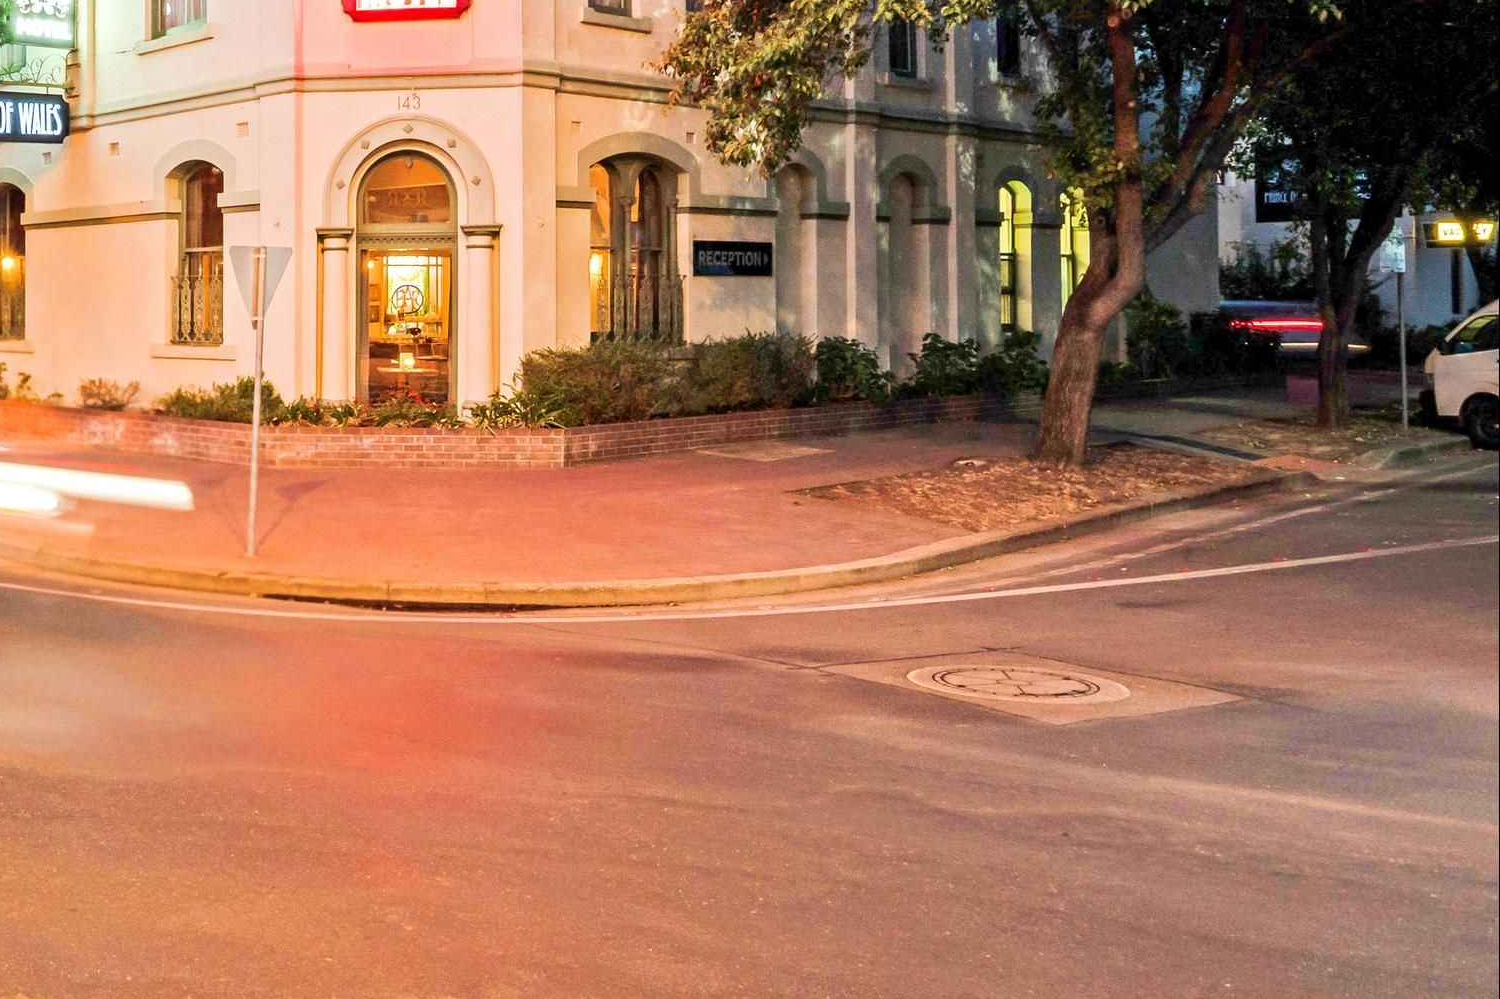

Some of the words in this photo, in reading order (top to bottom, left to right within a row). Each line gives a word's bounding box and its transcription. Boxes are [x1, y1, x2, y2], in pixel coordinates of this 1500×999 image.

[397, 96, 421, 110] 143
[18, 102, 62, 136] WALES
[698, 250, 762, 267] RECEPTION
[395, 286, 421, 312] BAR
